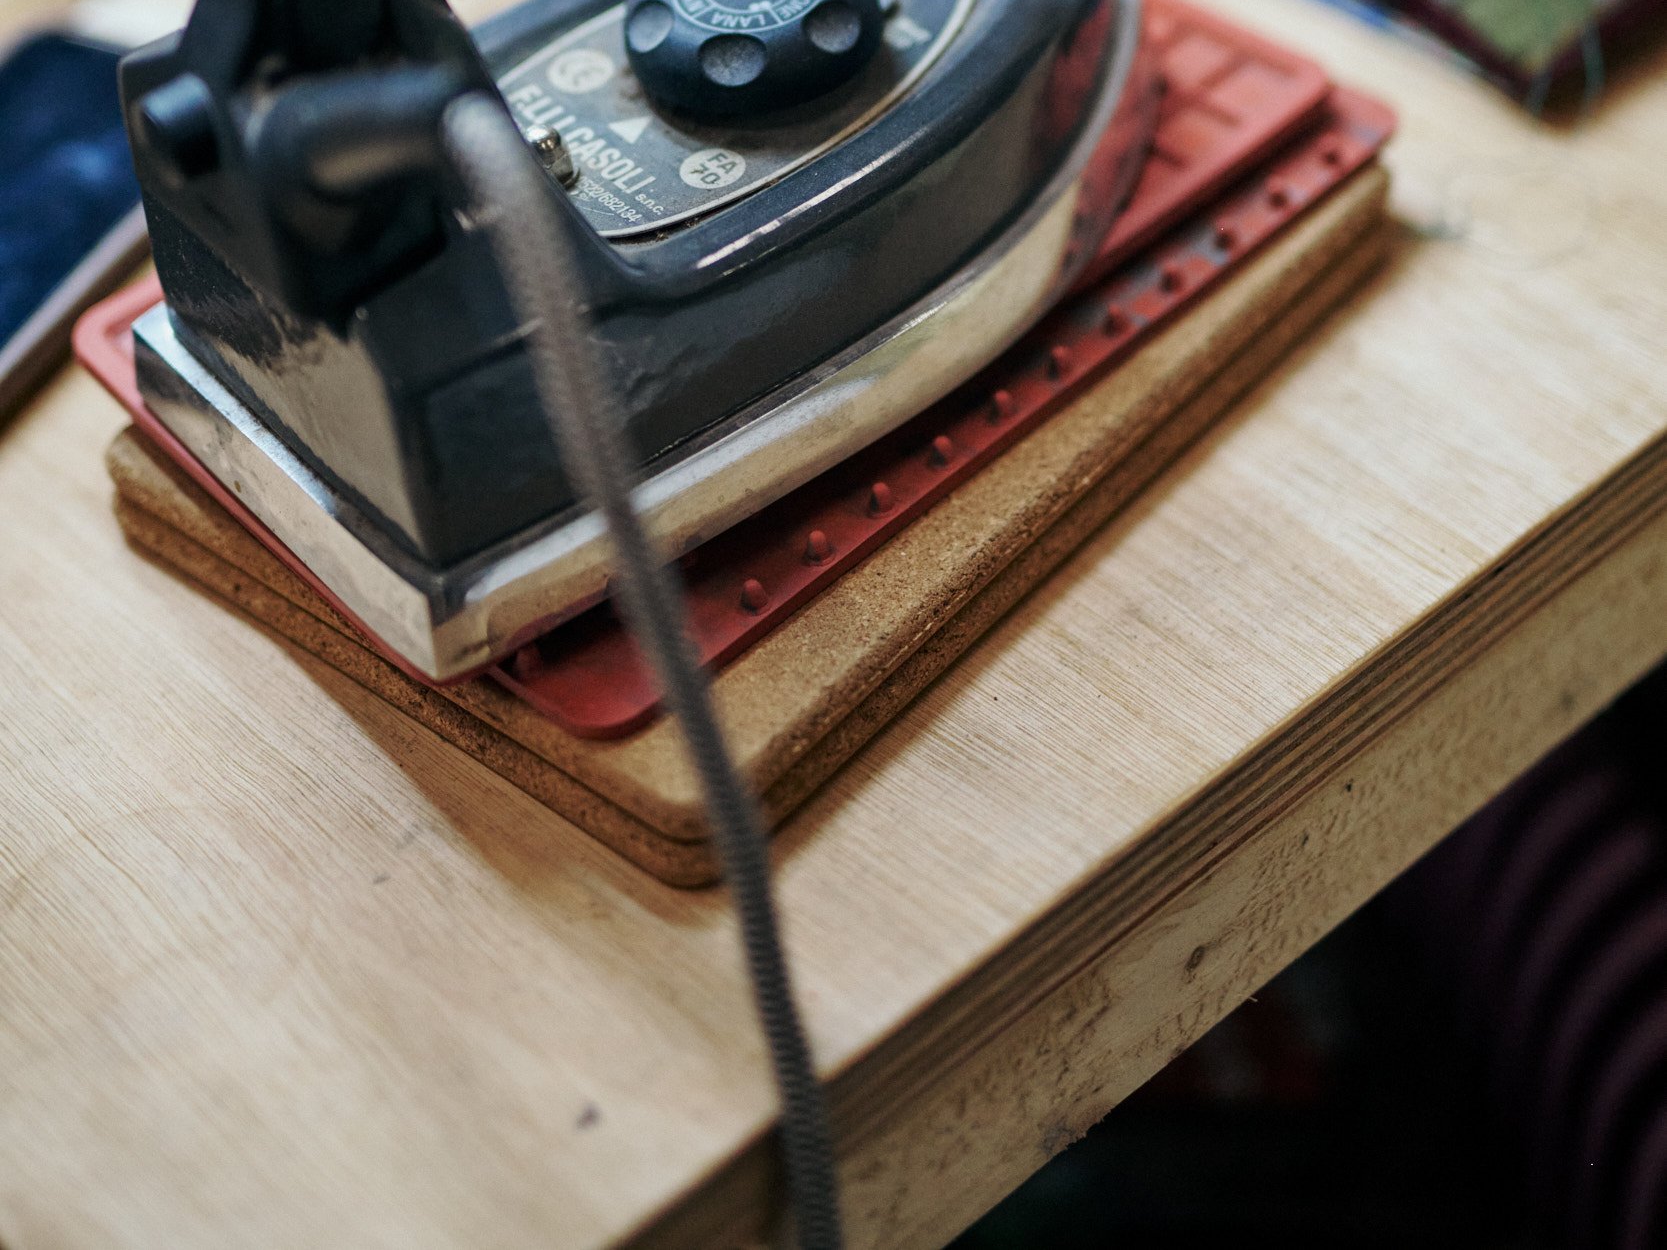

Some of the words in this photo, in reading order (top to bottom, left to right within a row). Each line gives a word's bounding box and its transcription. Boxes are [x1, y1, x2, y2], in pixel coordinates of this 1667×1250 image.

[710, 12, 766, 27] LANA
[566, 126, 657, 194] CASOLI
[707, 152, 739, 175] FA
[690, 167, 721, 186] 70
